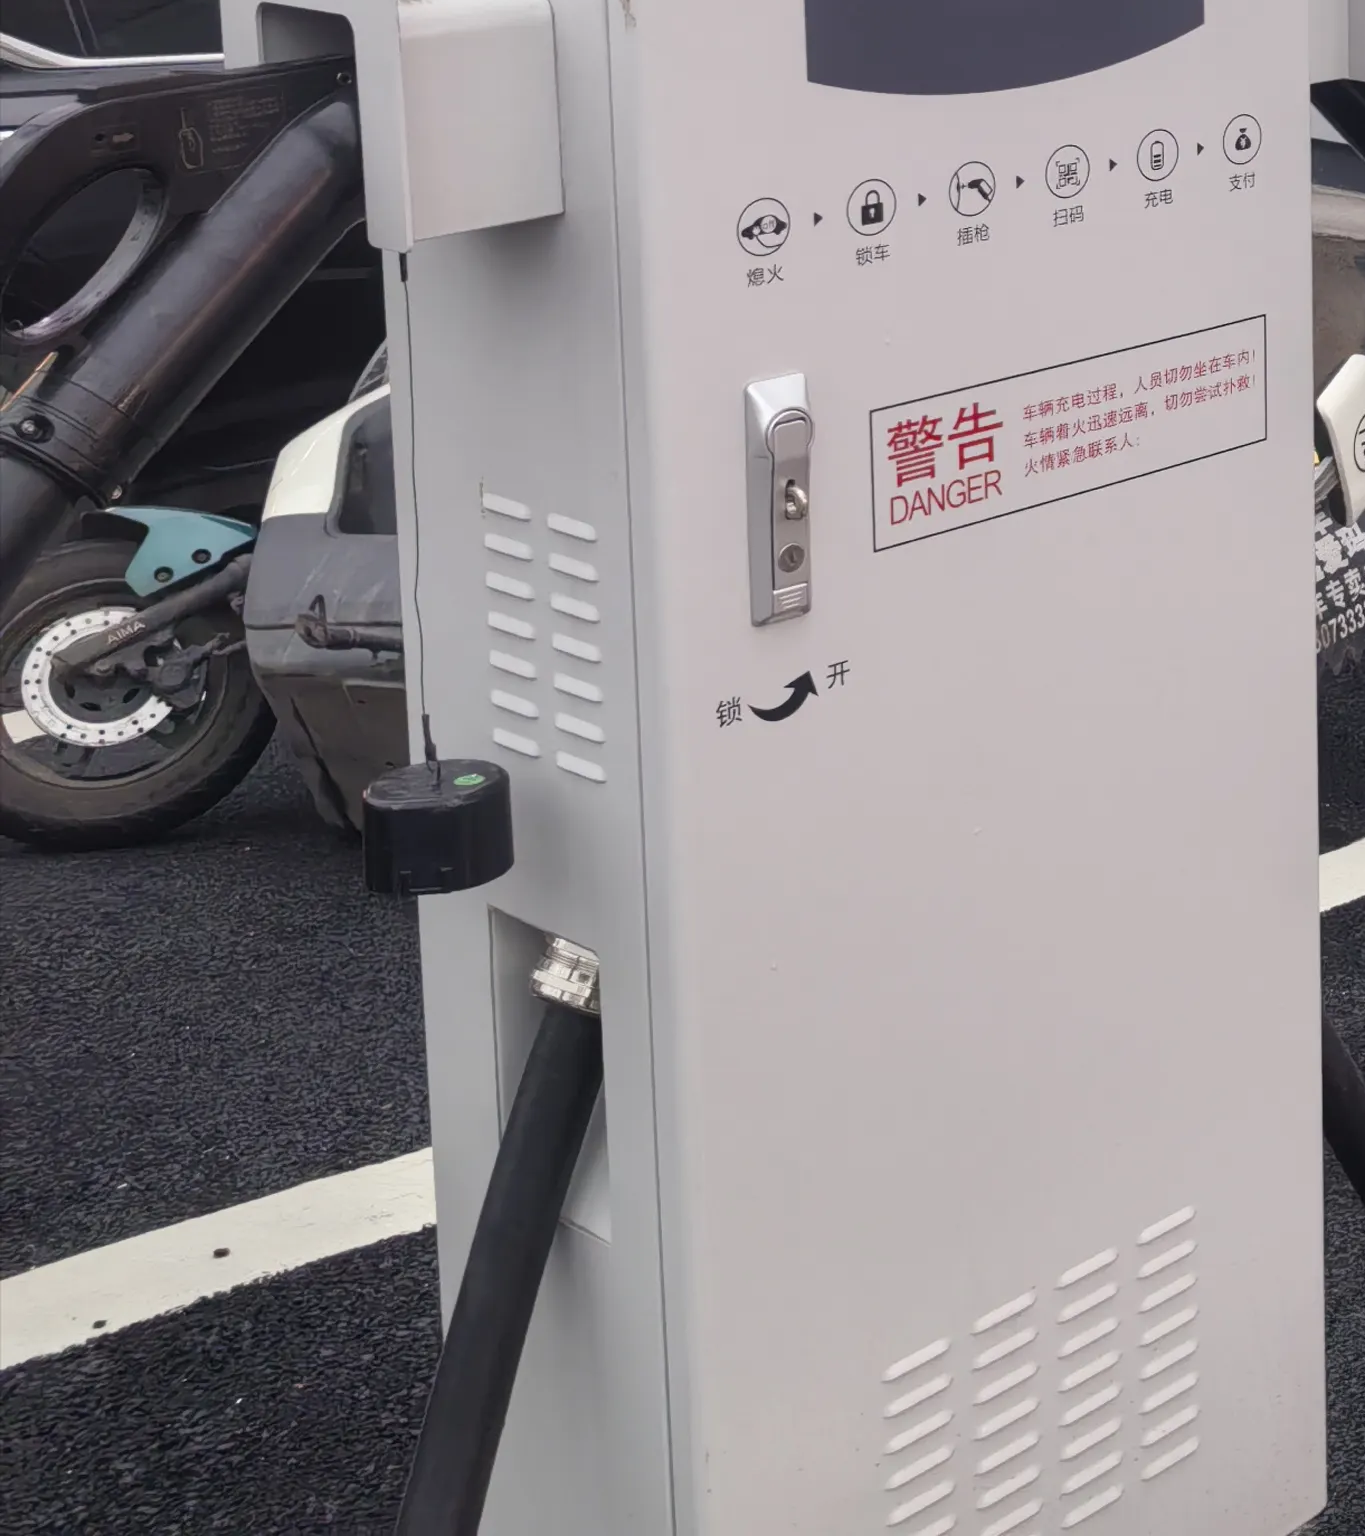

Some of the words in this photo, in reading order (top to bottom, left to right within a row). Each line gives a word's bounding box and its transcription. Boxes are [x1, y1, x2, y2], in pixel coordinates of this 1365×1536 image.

[746, 264, 785, 288] 熄火
[855, 243, 891, 266] 锁车
[957, 223, 990, 247] 插枪
[1052, 205, 1085, 228] 扫码
[1144, 188, 1174, 209] 充电
[1228, 171, 1256, 192] 支付
[886, 401, 1004, 488] 警告
[889, 468, 1003, 526] DANGER
[107, 621, 146, 644] AIMA
[715, 696, 743, 728] 锁
[826, 660, 851, 690] 开
